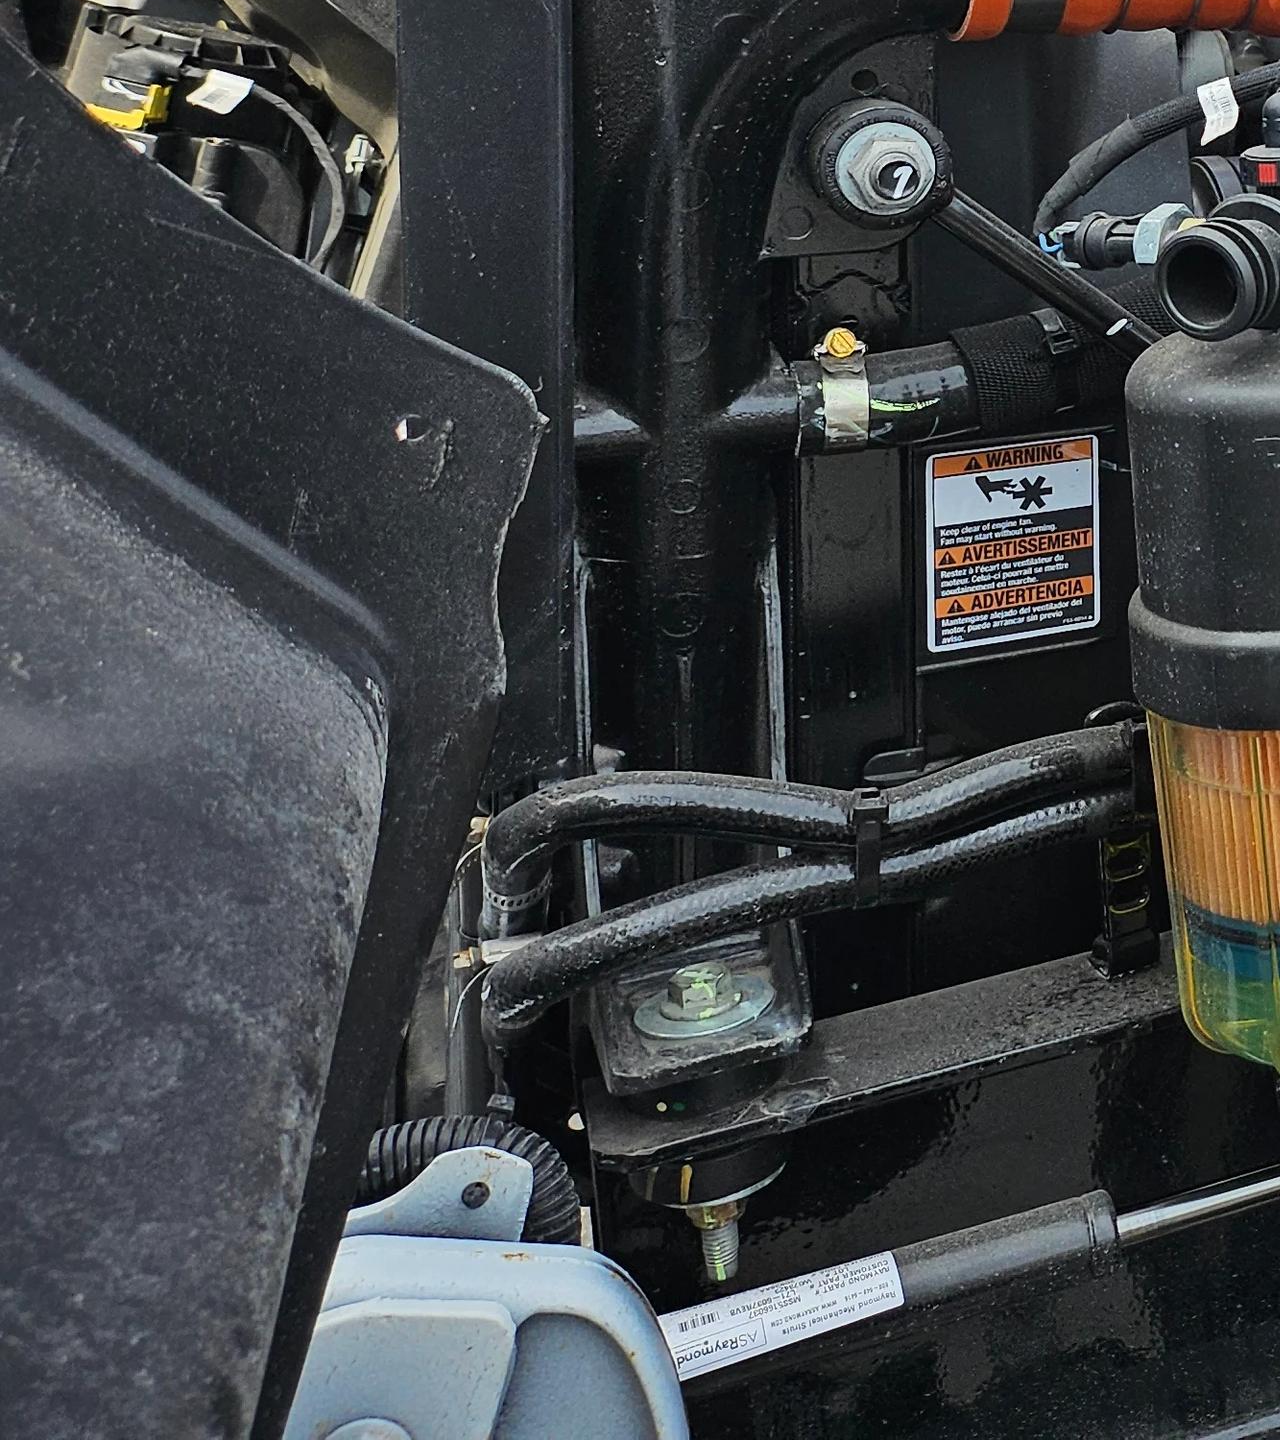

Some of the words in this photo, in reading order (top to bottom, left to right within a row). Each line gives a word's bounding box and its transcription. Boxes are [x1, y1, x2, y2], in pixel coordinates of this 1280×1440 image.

[986, 444, 1064, 469] WARNING
[940, 528, 959, 537] Keep
[961, 526, 980, 534] clear
[991, 521, 1017, 531] engine
[940, 537, 955, 546] Fan
[956, 535, 973, 544] may
[974, 532, 993, 541] start
[994, 528, 1023, 538] without
[1024, 524, 1057, 535] warning.
[962, 529, 1090, 563] AVERTISSEMENT
[940, 569, 967, 579] Restez
[1001, 561, 1012, 570] du
[971, 579, 1084, 611] ADVERTENCIA
[990, 610, 1018, 620] alejado
[1019, 607, 1031, 615] del
[1071, 598, 1082, 607] del
[967, 622, 991, 633] puede
[992, 618, 1025, 629] arrancar
[1026, 614, 1038, 622] sin
[1040, 610, 1063, 622] previo
[822, 1281, 846, 1294] PART
[675, 1329, 759, 1368] ASRaymond
